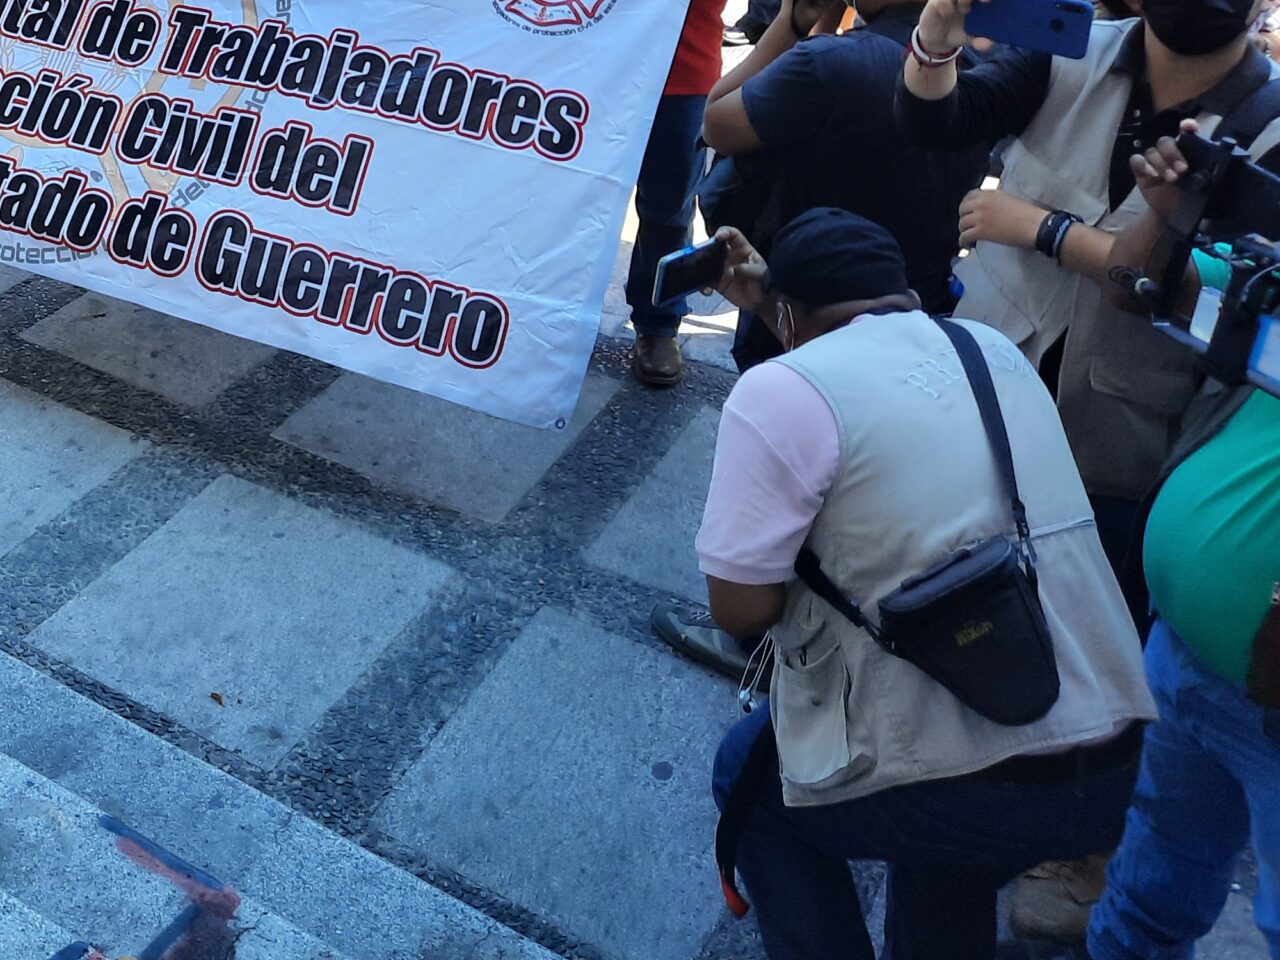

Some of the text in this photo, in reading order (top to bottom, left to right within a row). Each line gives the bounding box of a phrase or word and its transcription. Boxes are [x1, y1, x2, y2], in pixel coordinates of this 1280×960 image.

[115, 92, 261, 186] Civil
[249, 119, 374, 216] del
[158, 4, 589, 162] Trabajadores
[107, 190, 197, 278] de
[195, 209, 509, 369] Guerrero
